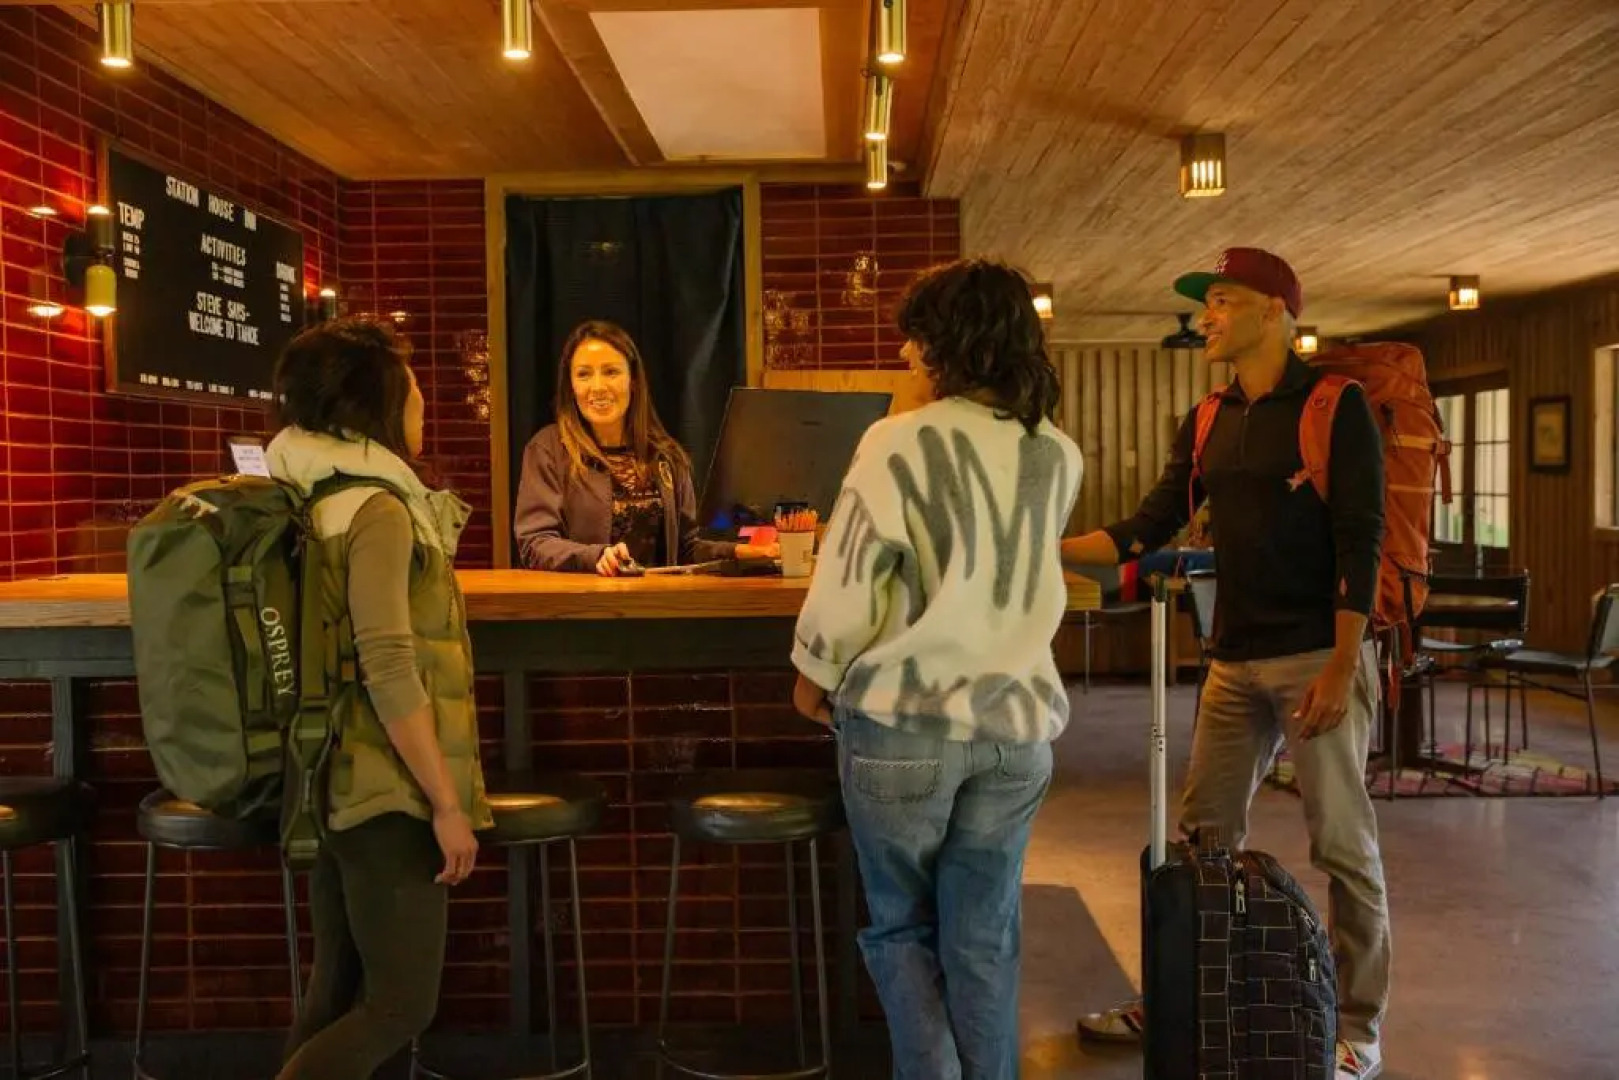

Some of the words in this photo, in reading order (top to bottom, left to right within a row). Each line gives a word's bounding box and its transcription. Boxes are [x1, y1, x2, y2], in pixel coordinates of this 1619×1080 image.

[165, 174, 199, 208] STATION
[208, 193, 234, 222] HOUSE
[117, 201, 144, 230] TEMP
[201, 233, 246, 267] ACTIVITIES
[197, 291, 222, 316] STEVE
[188, 310, 224, 338] WELCOME
[224, 320, 235, 340] TO
[236, 323, 259, 345] TAHOE
[260, 606, 297, 695] OSPREY
